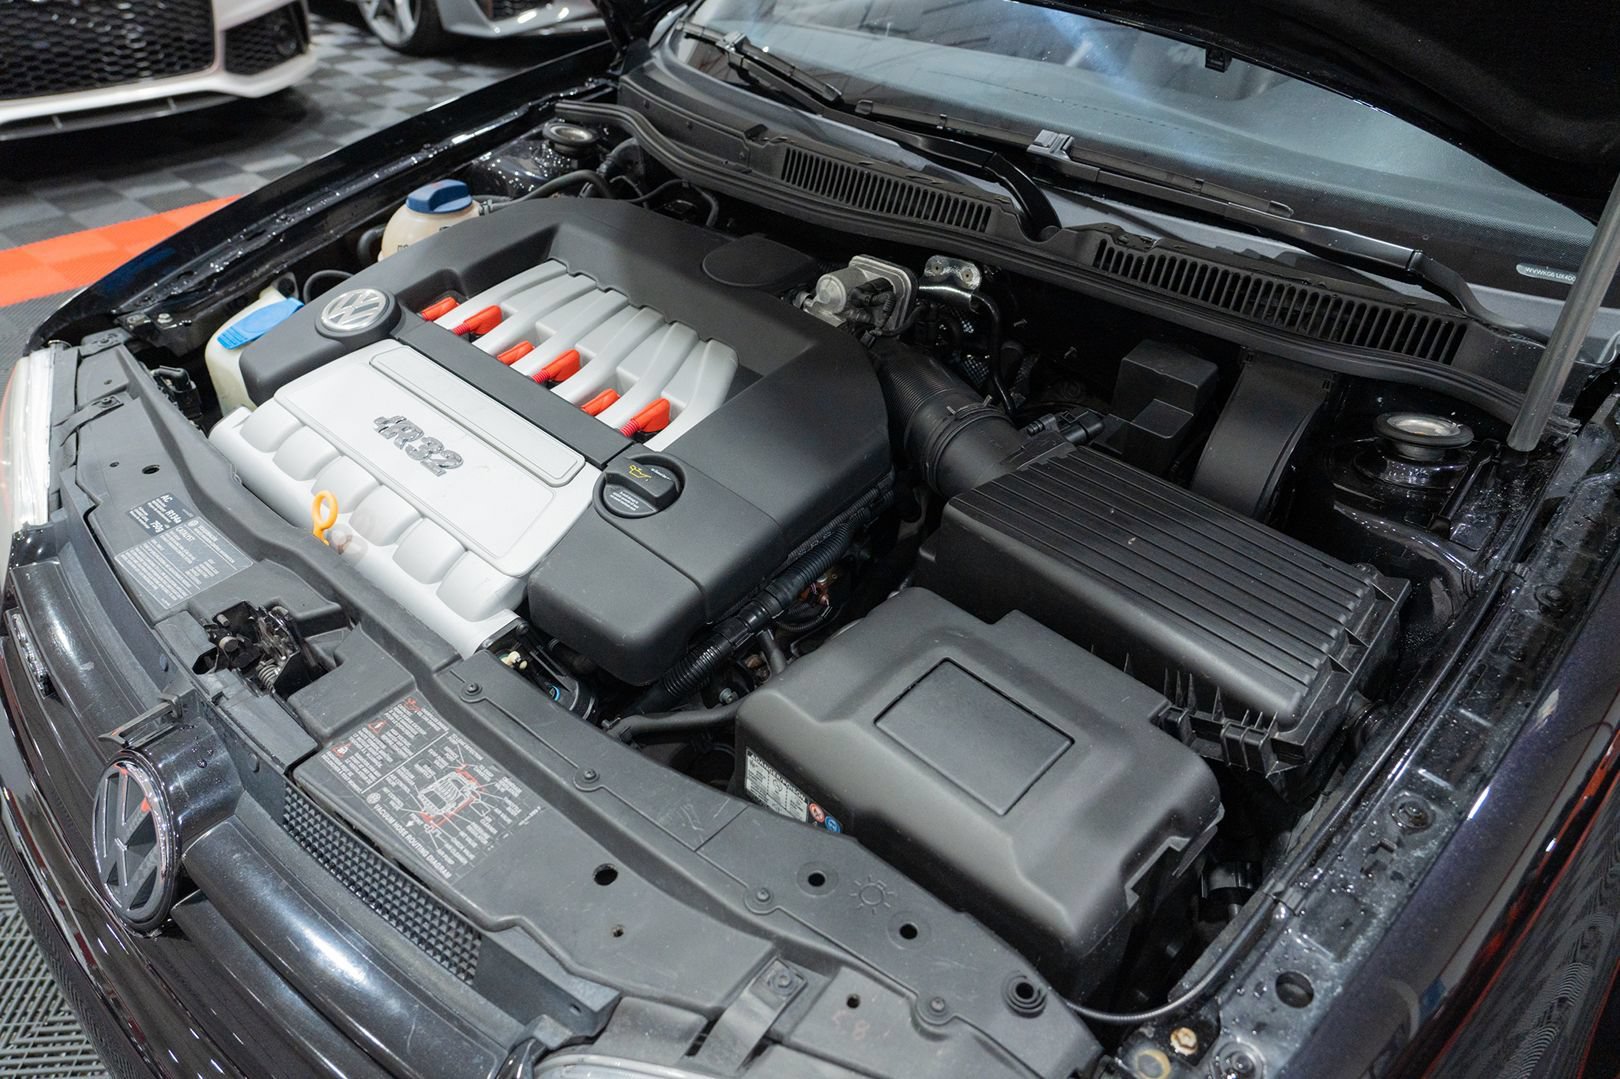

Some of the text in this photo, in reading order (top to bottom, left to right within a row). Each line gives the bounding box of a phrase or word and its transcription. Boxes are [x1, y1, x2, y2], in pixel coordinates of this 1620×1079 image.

[373, 415, 465, 477] R32
[160, 494, 174, 503] AC
[373, 802, 397, 824] VACUUM
[392, 820, 409, 836] HOSE
[404, 832, 430, 857] ROUTING
[425, 853, 452, 879] DIAGRAM
